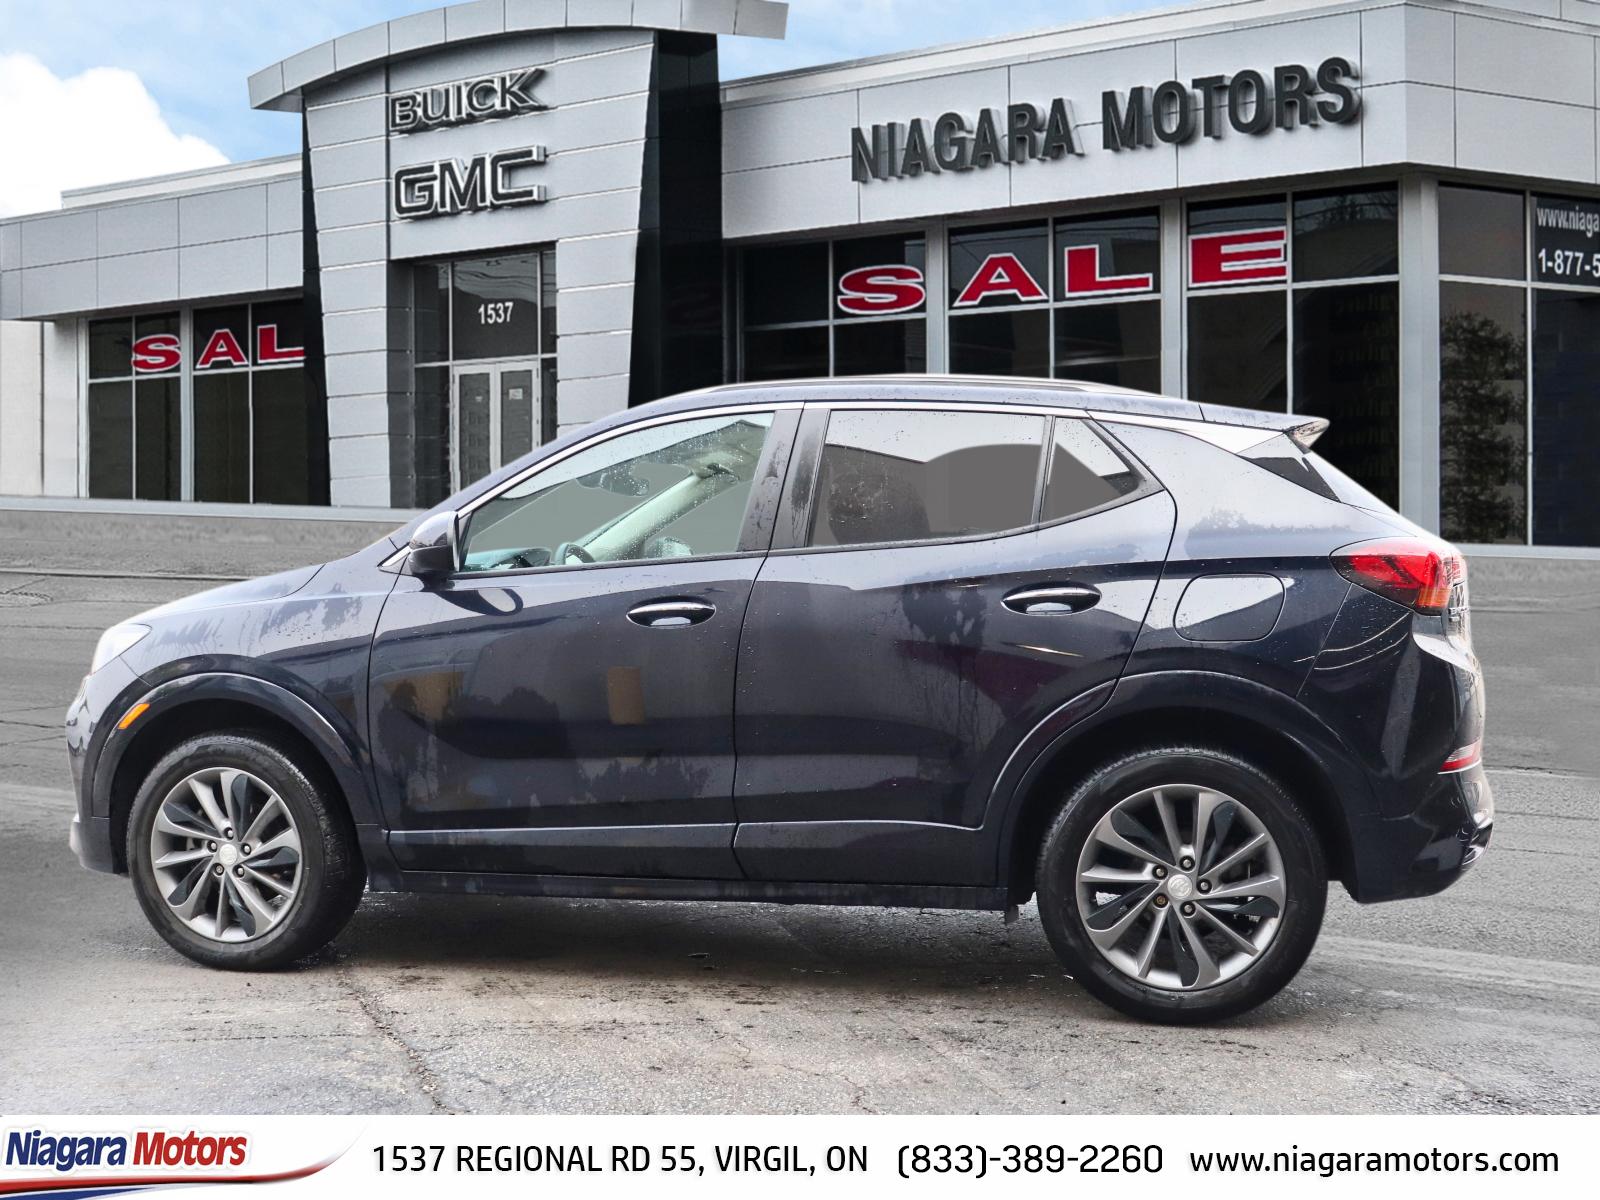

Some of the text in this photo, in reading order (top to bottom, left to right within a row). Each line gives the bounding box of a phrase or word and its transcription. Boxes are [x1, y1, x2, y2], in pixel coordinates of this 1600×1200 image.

[389, 68, 548, 133] BUICK
[851, 56, 1362, 183] NIAGARA MOTORS
[394, 145, 548, 218] GMC
[838, 227, 1288, 315] SALE
[478, 302, 514, 324] 1537
[132, 323, 305, 373] SAL
